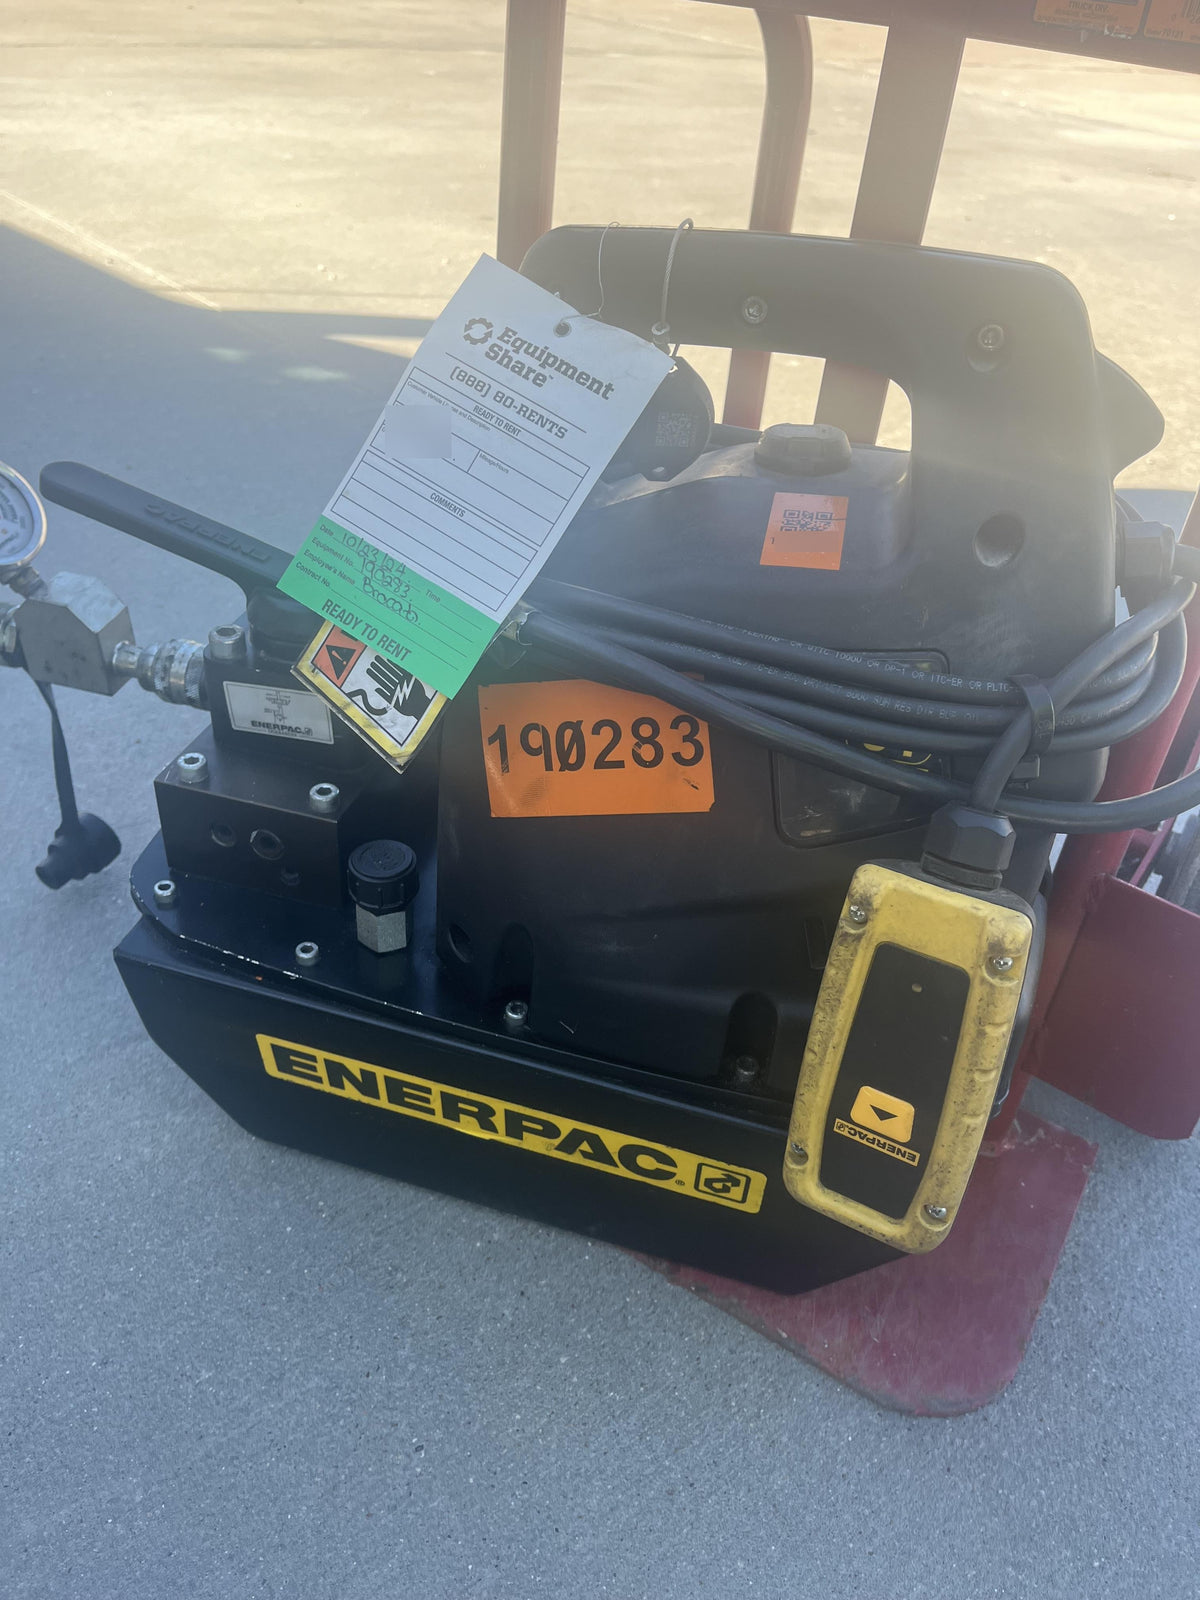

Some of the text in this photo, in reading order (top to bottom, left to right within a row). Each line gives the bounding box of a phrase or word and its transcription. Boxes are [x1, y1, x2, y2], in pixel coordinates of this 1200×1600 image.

[497, 327, 614, 400] Equipment
[407, 380, 428, 396] Customer
[427, 392, 443, 405] Vehicle
[467, 415, 491, 432] Description
[449, 366, 569, 439] (888) 80-RENTS
[473, 405, 522, 438] READY TO RENT
[430, 492, 466, 518] COMMENTS
[319, 524, 334, 537] Date
[311, 536, 344, 561] Equipment
[295, 561, 321, 582] Contract
[303, 549, 356, 586] Employee's Name
[425, 589, 441, 603] Time
[321, 598, 412, 662] READY TO RENT
[911, 670, 926, 680] OR
[930, 673, 963, 689] ITC-ER
[968, 680, 982, 691] OR
[250, 720, 302, 735] ENERPAC
[487, 715, 704, 774] 190283
[270, 1043, 677, 1182] ENERPAC
[847, 1125, 917, 1163] ENERPAC
